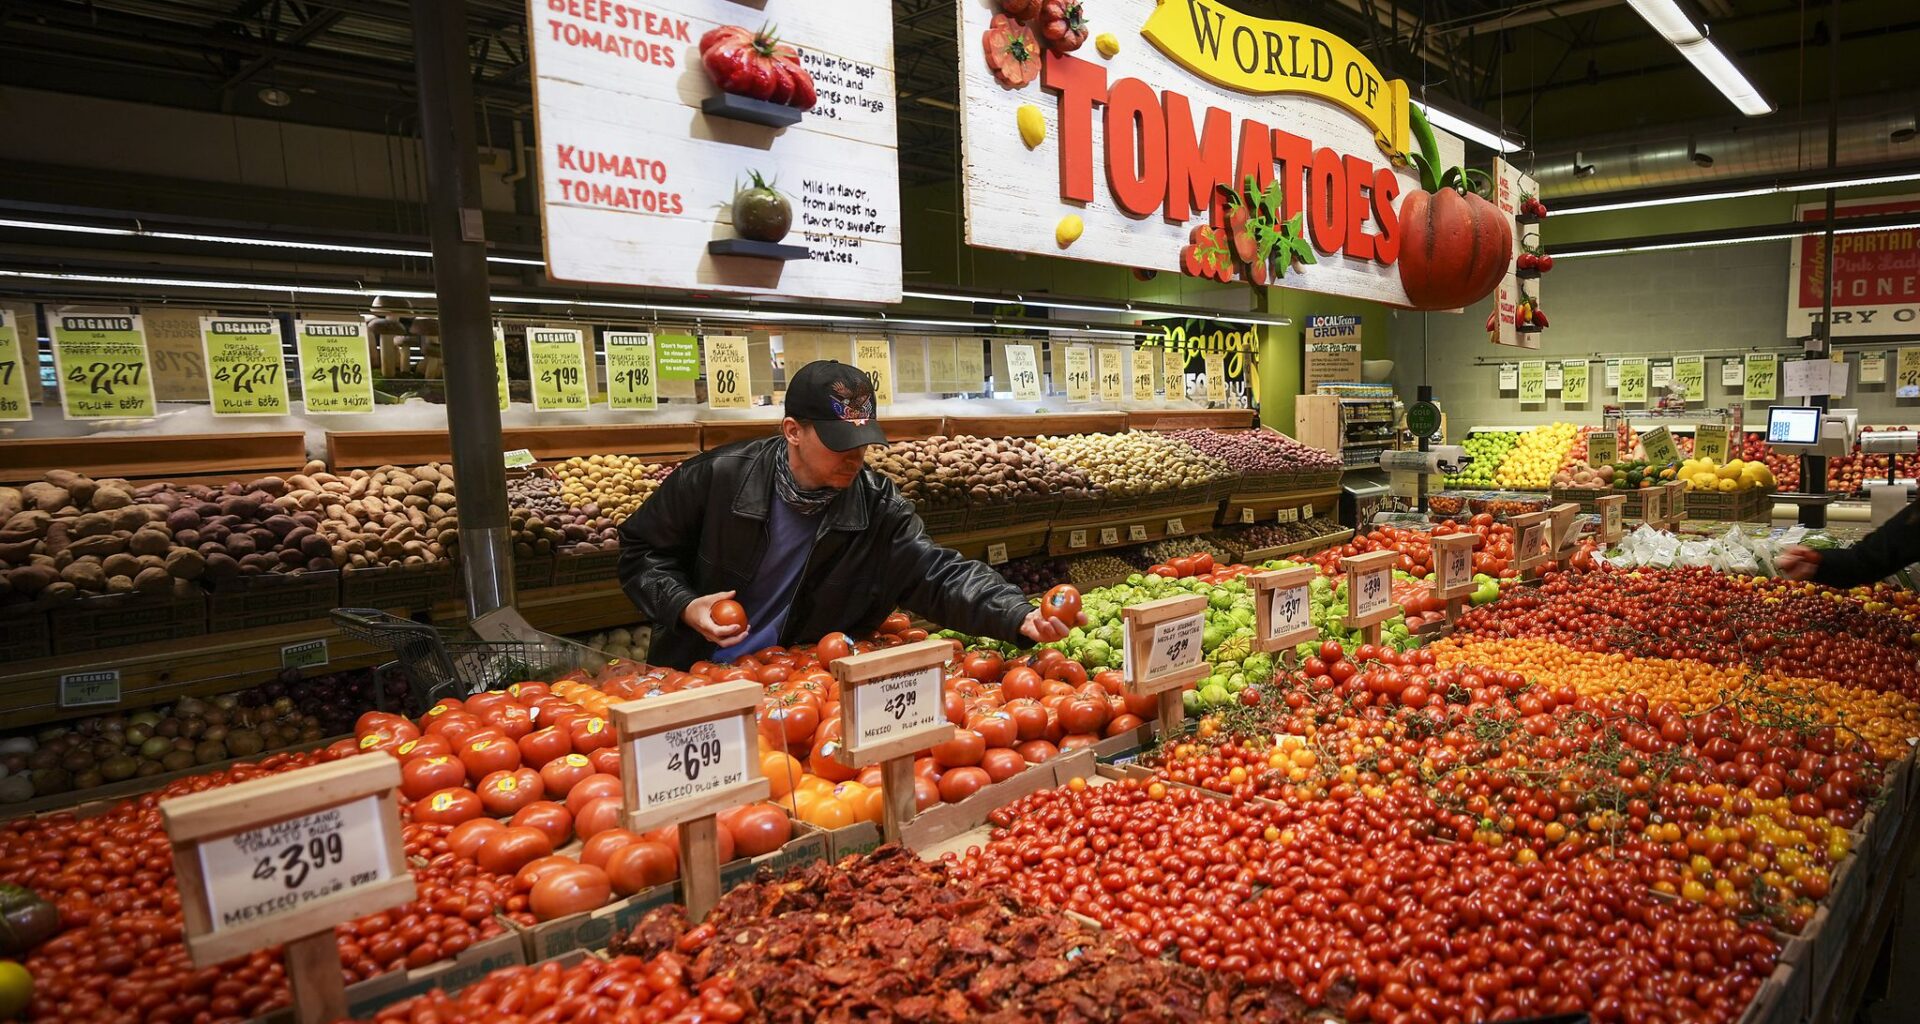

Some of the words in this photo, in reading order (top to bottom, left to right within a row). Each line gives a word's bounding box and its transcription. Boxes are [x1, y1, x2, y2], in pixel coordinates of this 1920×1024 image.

[548, 0, 692, 43] BEEFSTEAK
[548, 19, 676, 69] TOMATOES
[797, 48, 836, 68] Popular
[838, 58, 852, 71] for
[855, 62, 875, 78] beef
[1188, 0, 1334, 82] WORLD
[1345, 61, 1379, 110] OF
[809, 69, 842, 86] ndwich
[846, 80, 863, 90] and
[844, 95, 857, 105] on
[859, 95, 884, 113] large
[557, 144, 667, 185] KUMATO
[1041, 50, 1400, 267] TOMATOES
[803, 180, 822, 194] Mild
[827, 183, 834, 195] in
[558, 179, 684, 215] TOMATOES
[803, 196, 826, 210] from
[829, 200, 861, 215] almost
[865, 207, 877, 218] no
[803, 213, 832, 227] flavor
[835, 218, 845, 230] to
[847, 221, 886, 233] sweeter
[803, 231, 827, 242] than
[1833, 231, 1913, 254] SPARTAN
[809, 250, 858, 265] omatoes.
[68, 318, 129, 330] ORGANIC
[215, 323, 269, 334] ORGANIC
[1313, 316, 1339, 327] LOCAL
[308, 325, 357, 336] ORGANIC
[536, 332, 575, 343] ORGANIC
[1313, 325, 1356, 338] GROWN
[224, 343, 260, 351] ORGANIC
[612, 336, 647, 346] ORGANIC
[78, 400, 115, 410] PLU#
[223, 399, 253, 407] PLU#
[311, 398, 339, 406] PLU#
[1274, 625, 1291, 635] MEXICO
[287, 642, 321, 654] ORGANIC
[1150, 664, 1168, 674] MEXICO
[69, 673, 112, 683] ORGANIC
[881, 679, 918, 693] TOMATOES
[884, 690, 917, 720] $399
[865, 724, 891, 738] MEXICO
[902, 721, 918, 730] PLU#
[669, 730, 717, 749] TOMATOES
[667, 739, 721, 781] $699
[647, 783, 693, 805] MEXICO
[695, 780, 720, 791] PLU#
[233, 832, 264, 846] SAN
[269, 810, 341, 836] MARZANO
[239, 831, 302, 855] TOMATO
[308, 820, 344, 837] BULK
[252, 832, 343, 889] $399
[223, 892, 299, 926] MEXICO
[301, 882, 343, 902] PLU#
